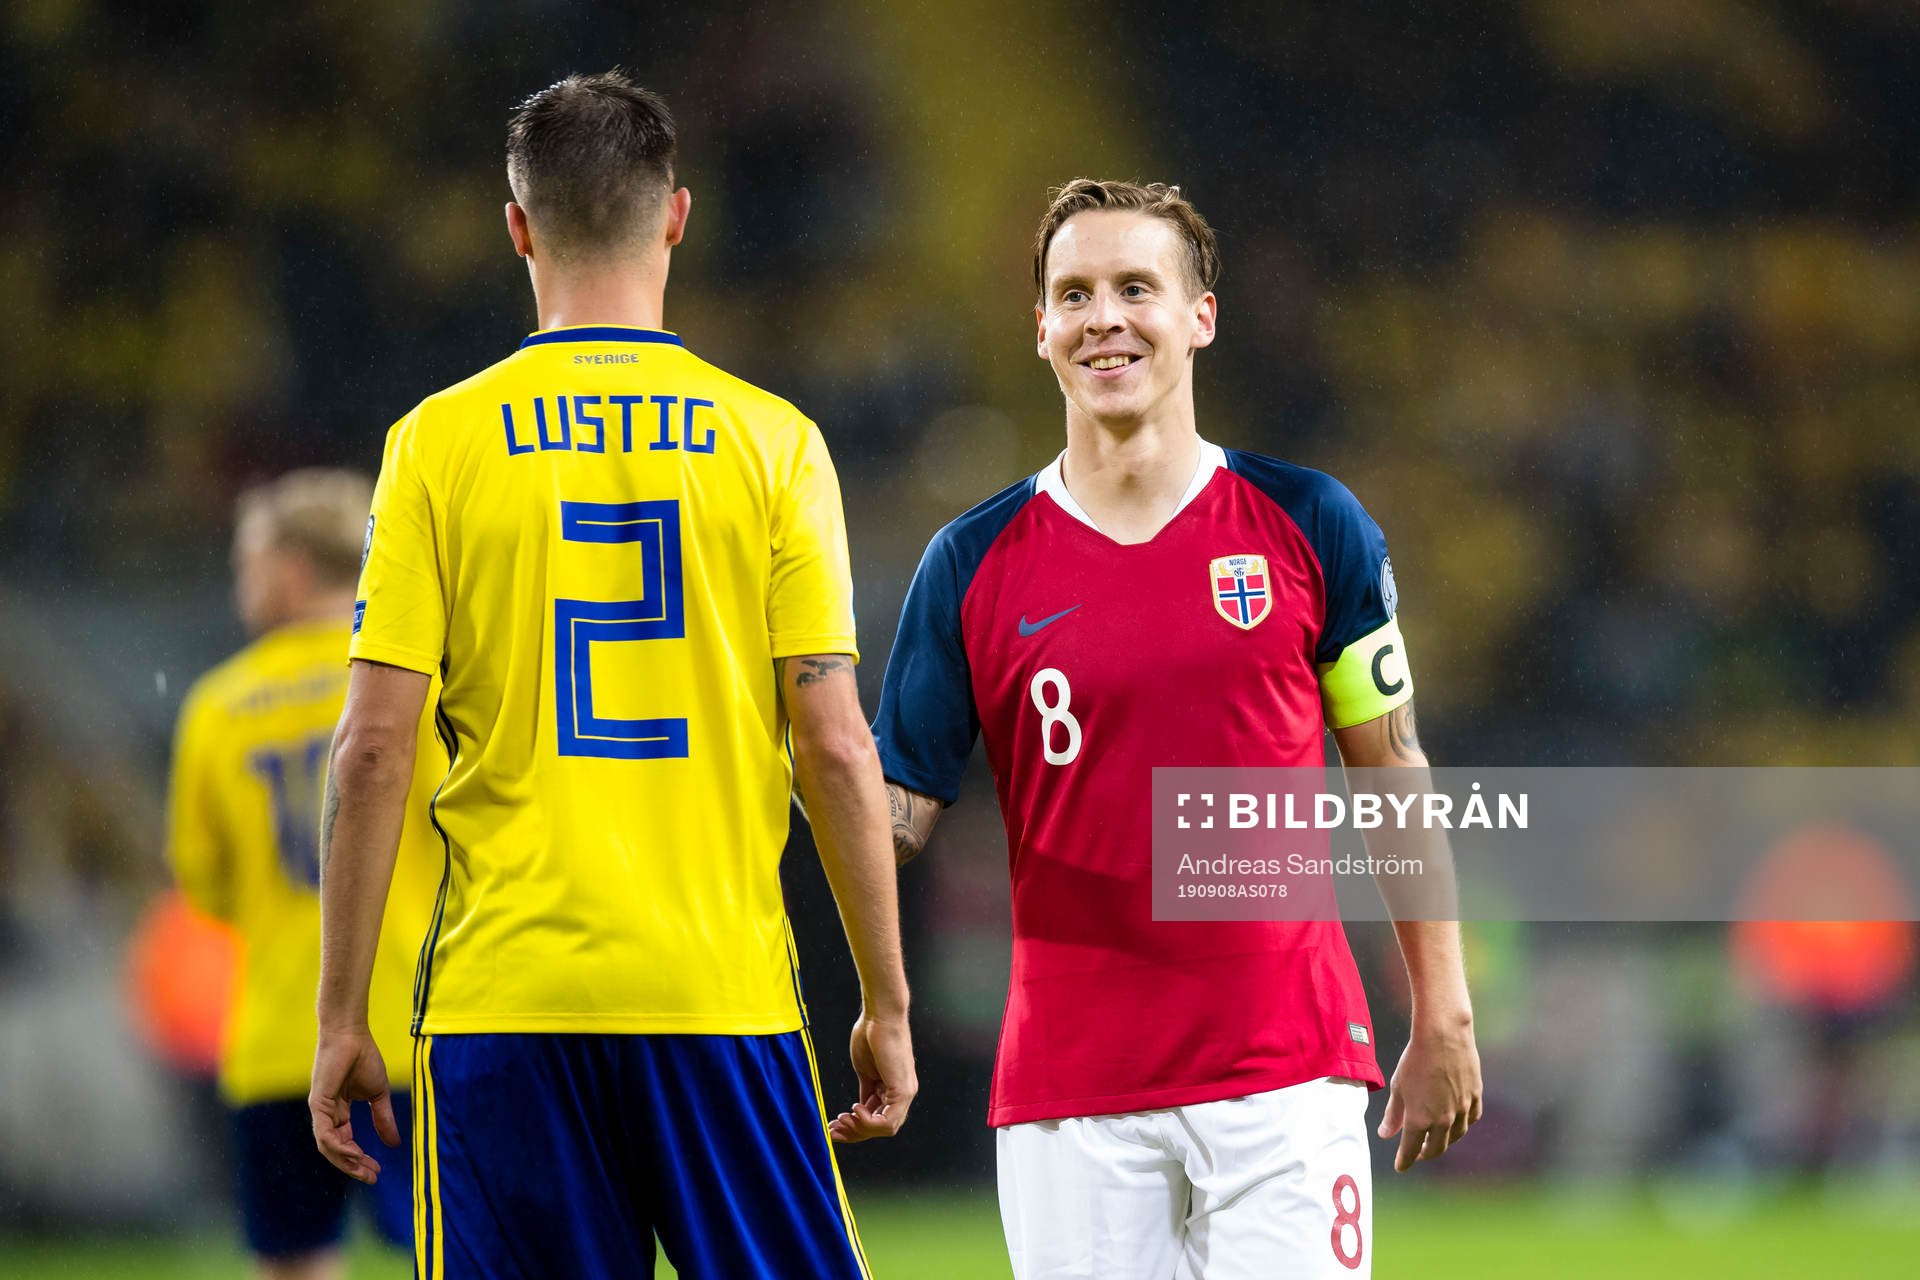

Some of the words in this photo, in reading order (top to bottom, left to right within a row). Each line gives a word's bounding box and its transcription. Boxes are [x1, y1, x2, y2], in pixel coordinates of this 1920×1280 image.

[573, 353, 640, 365] SVERIGE
[501, 395, 717, 456] LUSTIG
[554, 499, 689, 759] 2
[1371, 644, 1405, 697] C
[1030, 667, 1083, 766] 8
[1331, 1174, 1362, 1269] 8
